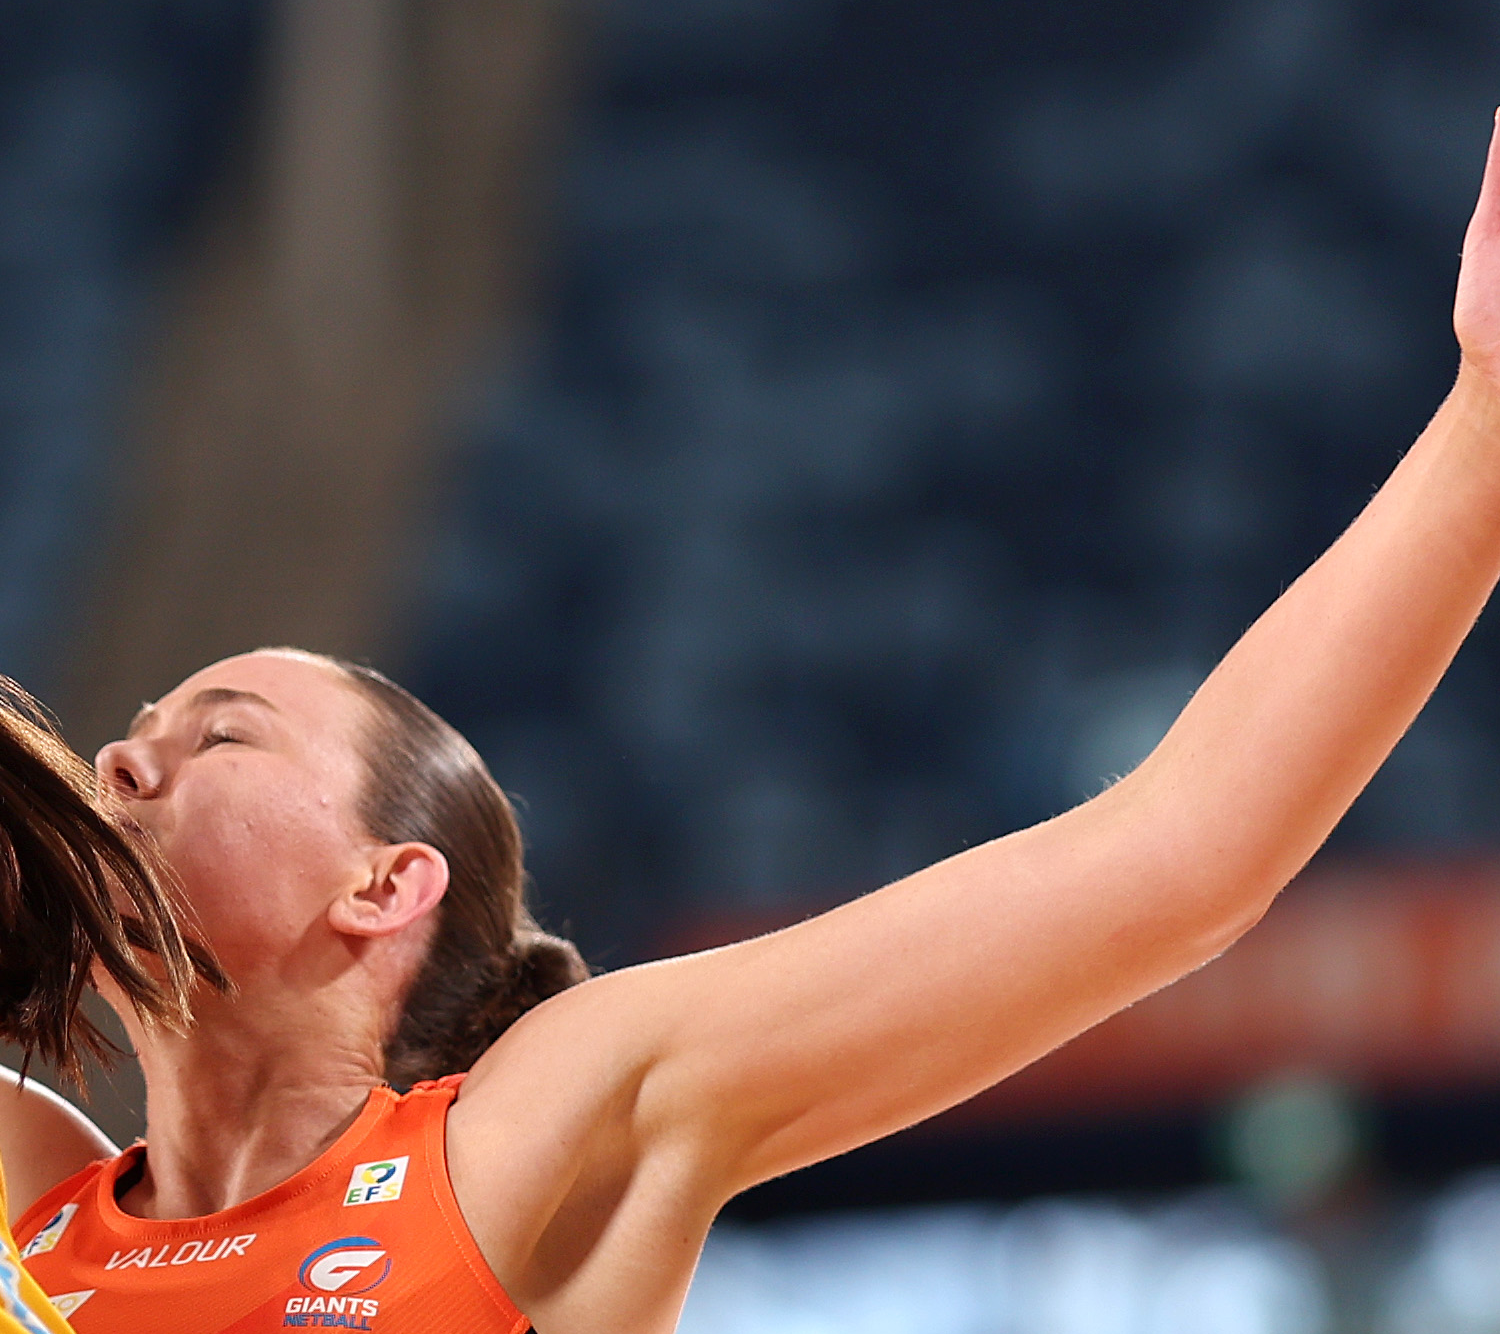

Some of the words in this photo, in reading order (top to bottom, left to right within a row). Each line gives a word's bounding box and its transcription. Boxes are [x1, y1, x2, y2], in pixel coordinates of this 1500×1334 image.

[346, 1183, 400, 1204] EFS
[104, 1234, 258, 1271] VALOUR
[285, 1296, 379, 1317] GIANTS
[283, 1312, 372, 1331] NETBALL
